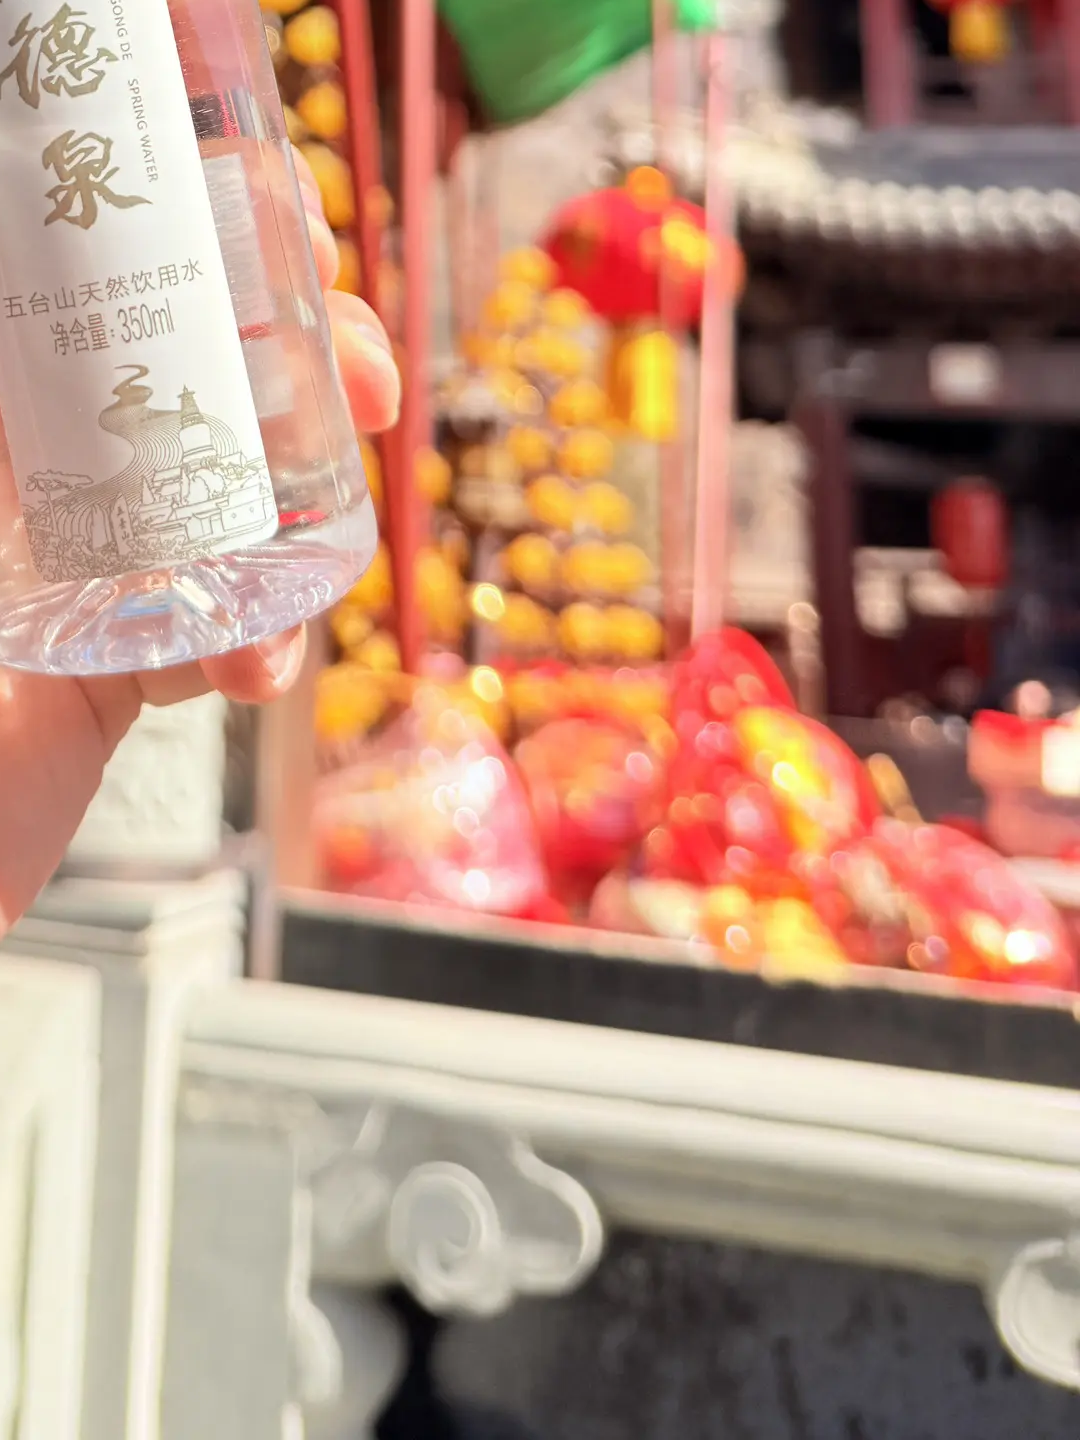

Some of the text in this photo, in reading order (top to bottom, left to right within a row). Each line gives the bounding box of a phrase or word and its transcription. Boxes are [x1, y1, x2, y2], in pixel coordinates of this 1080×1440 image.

[120, 42, 133, 61] DE
[127, 78, 148, 130] SPRING
[140, 134, 159, 183] WATER
[3, 258, 204, 319] 五台山天然饮用水
